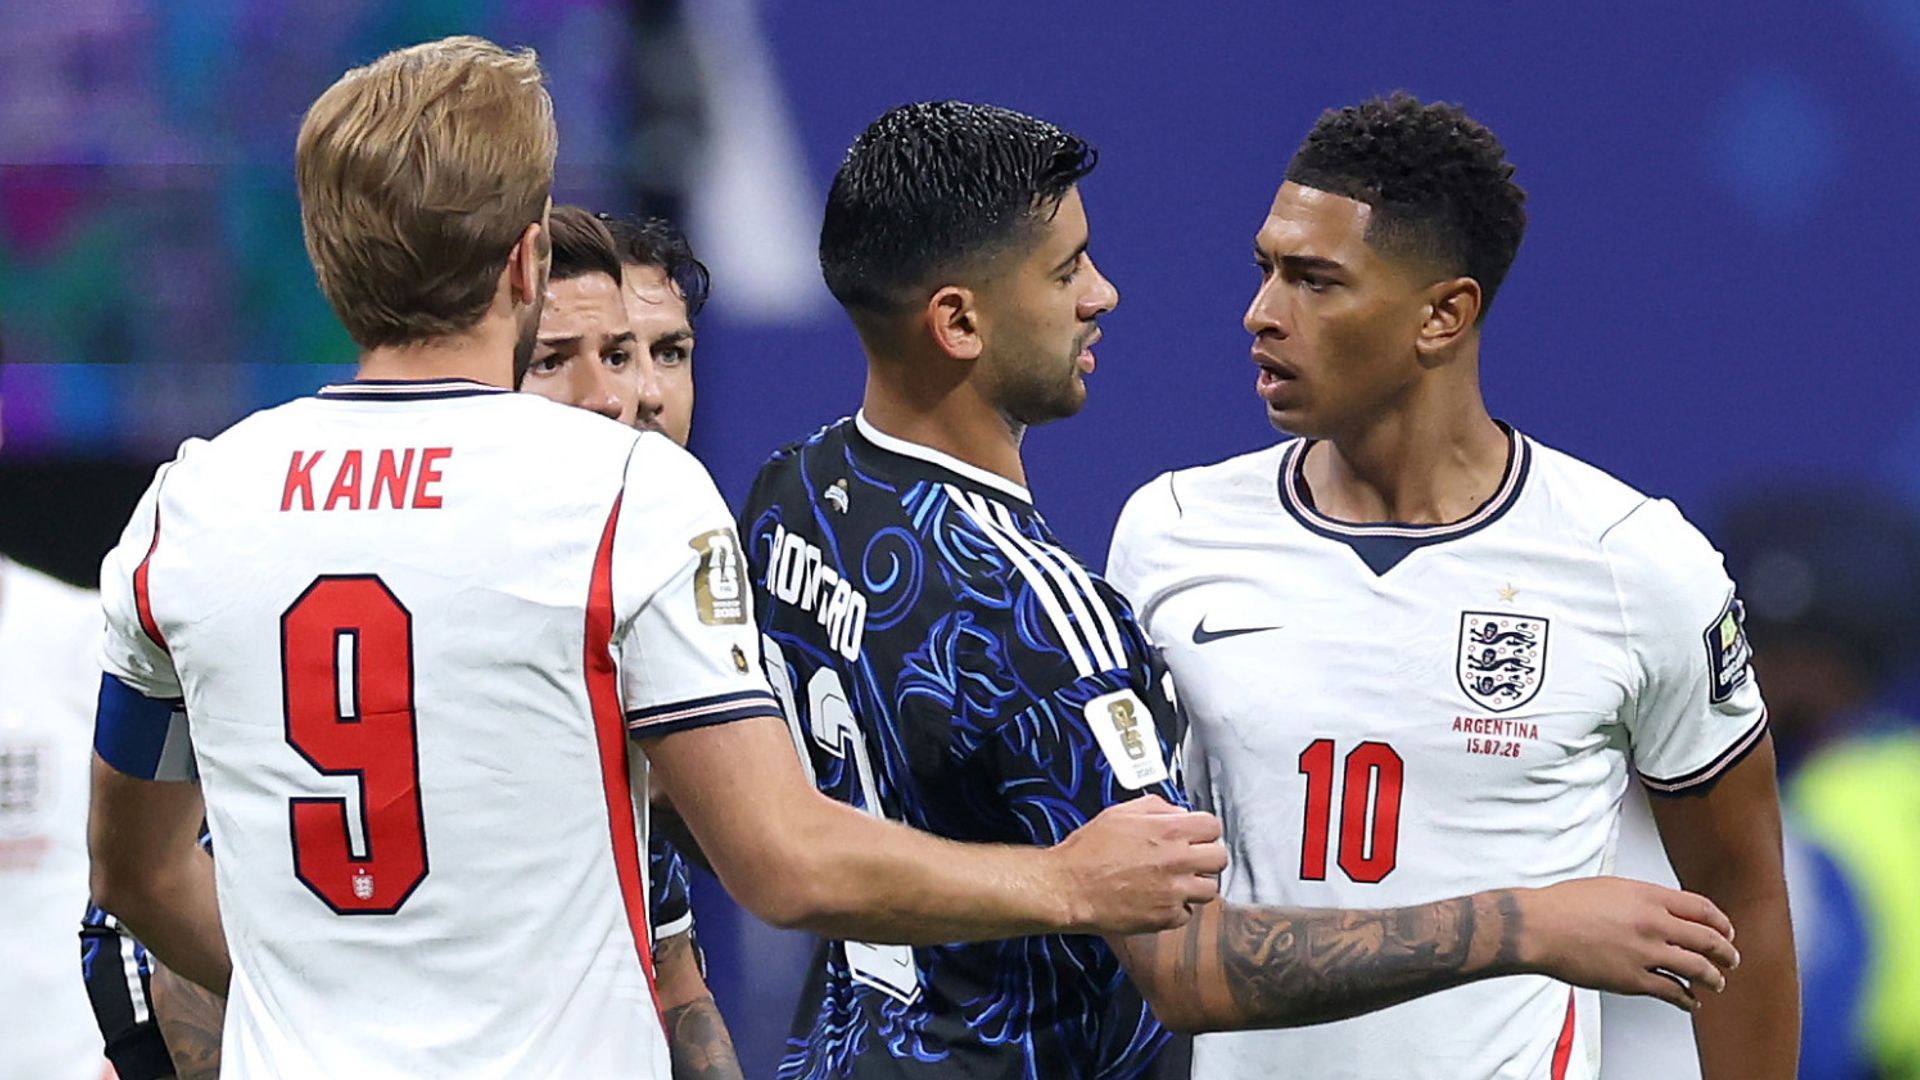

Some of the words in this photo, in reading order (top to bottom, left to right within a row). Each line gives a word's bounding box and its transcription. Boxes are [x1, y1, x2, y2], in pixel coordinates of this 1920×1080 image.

[280, 447, 452, 512] KANE
[279, 573, 430, 916] 9
[1452, 716, 1538, 740] ARGENTINA
[1466, 738, 1521, 758] 15.07.26
[1298, 738, 1404, 884] 10
